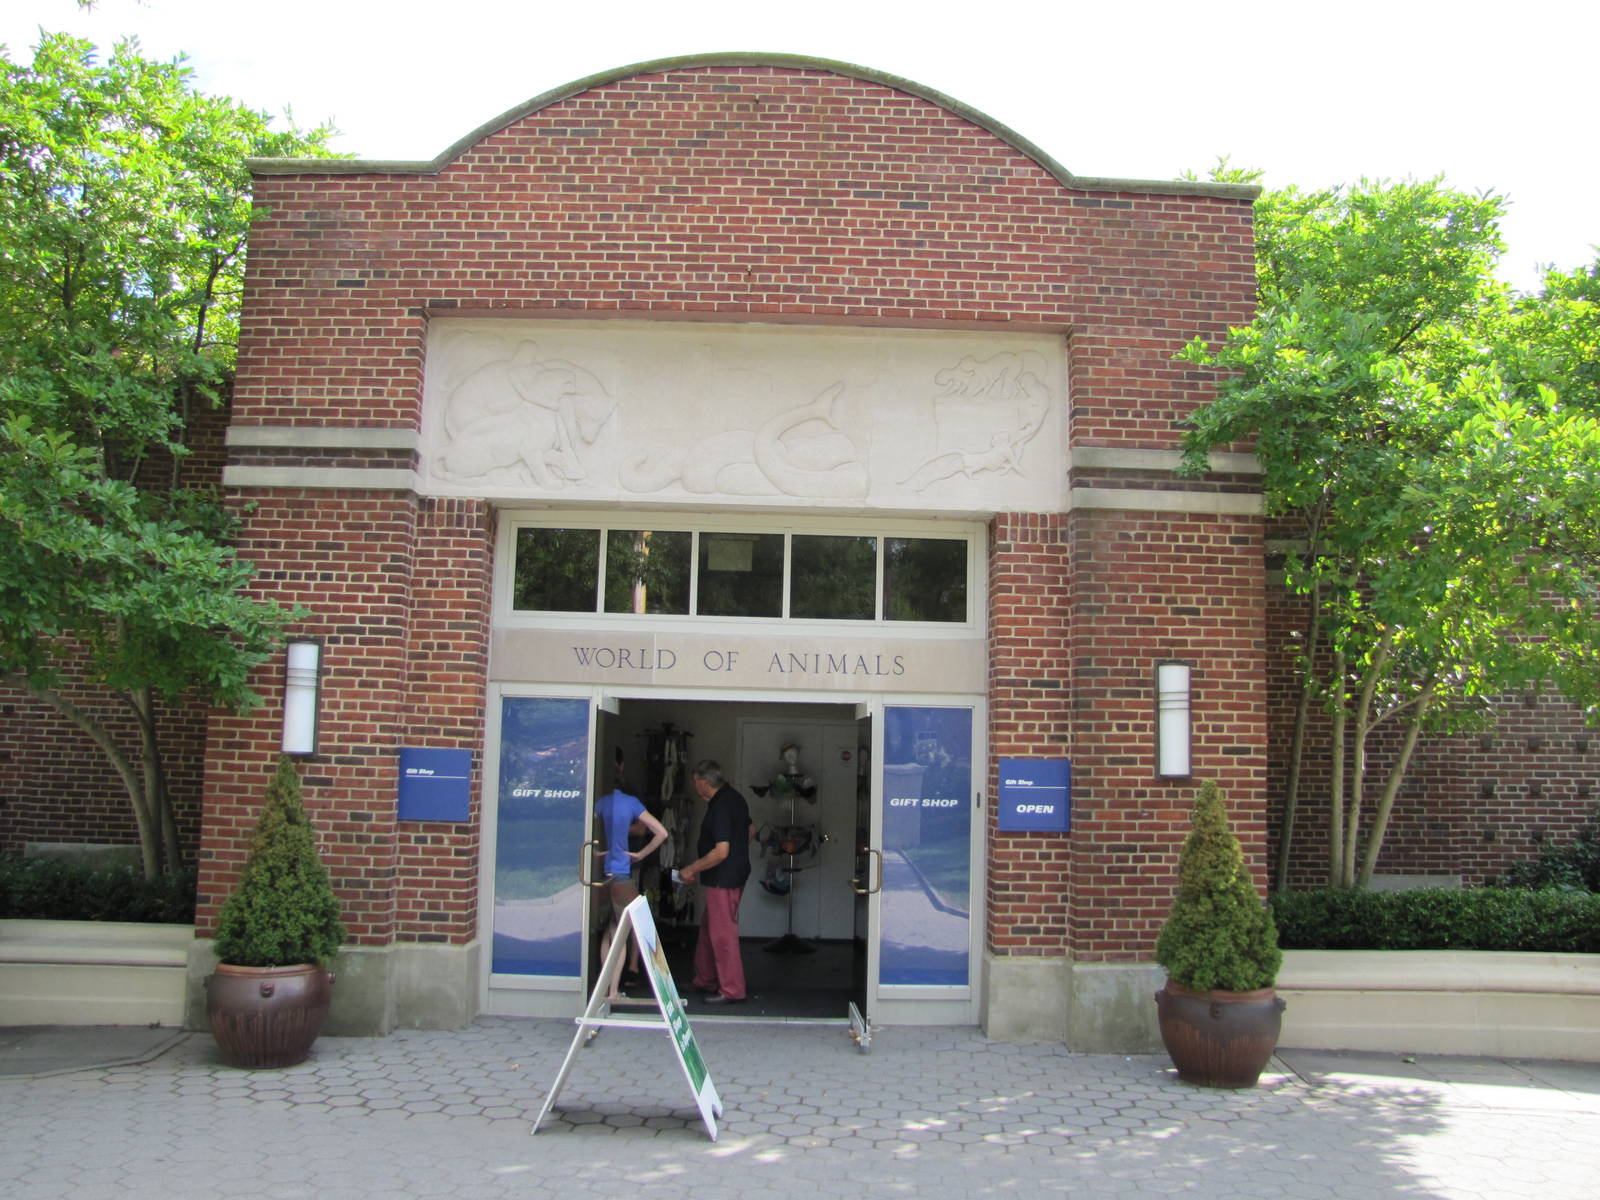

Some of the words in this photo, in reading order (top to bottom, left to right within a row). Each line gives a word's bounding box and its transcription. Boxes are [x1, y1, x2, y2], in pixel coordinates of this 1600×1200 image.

[574, 647, 677, 670] WORLD
[703, 650, 739, 672] OF
[767, 652, 906, 676] ANIMALS
[512, 788, 541, 797] GIFT
[544, 790, 580, 798] SHOP
[890, 798, 919, 806] GIFT
[921, 799, 958, 807] SHOP
[1016, 804, 1055, 814] OPEN
